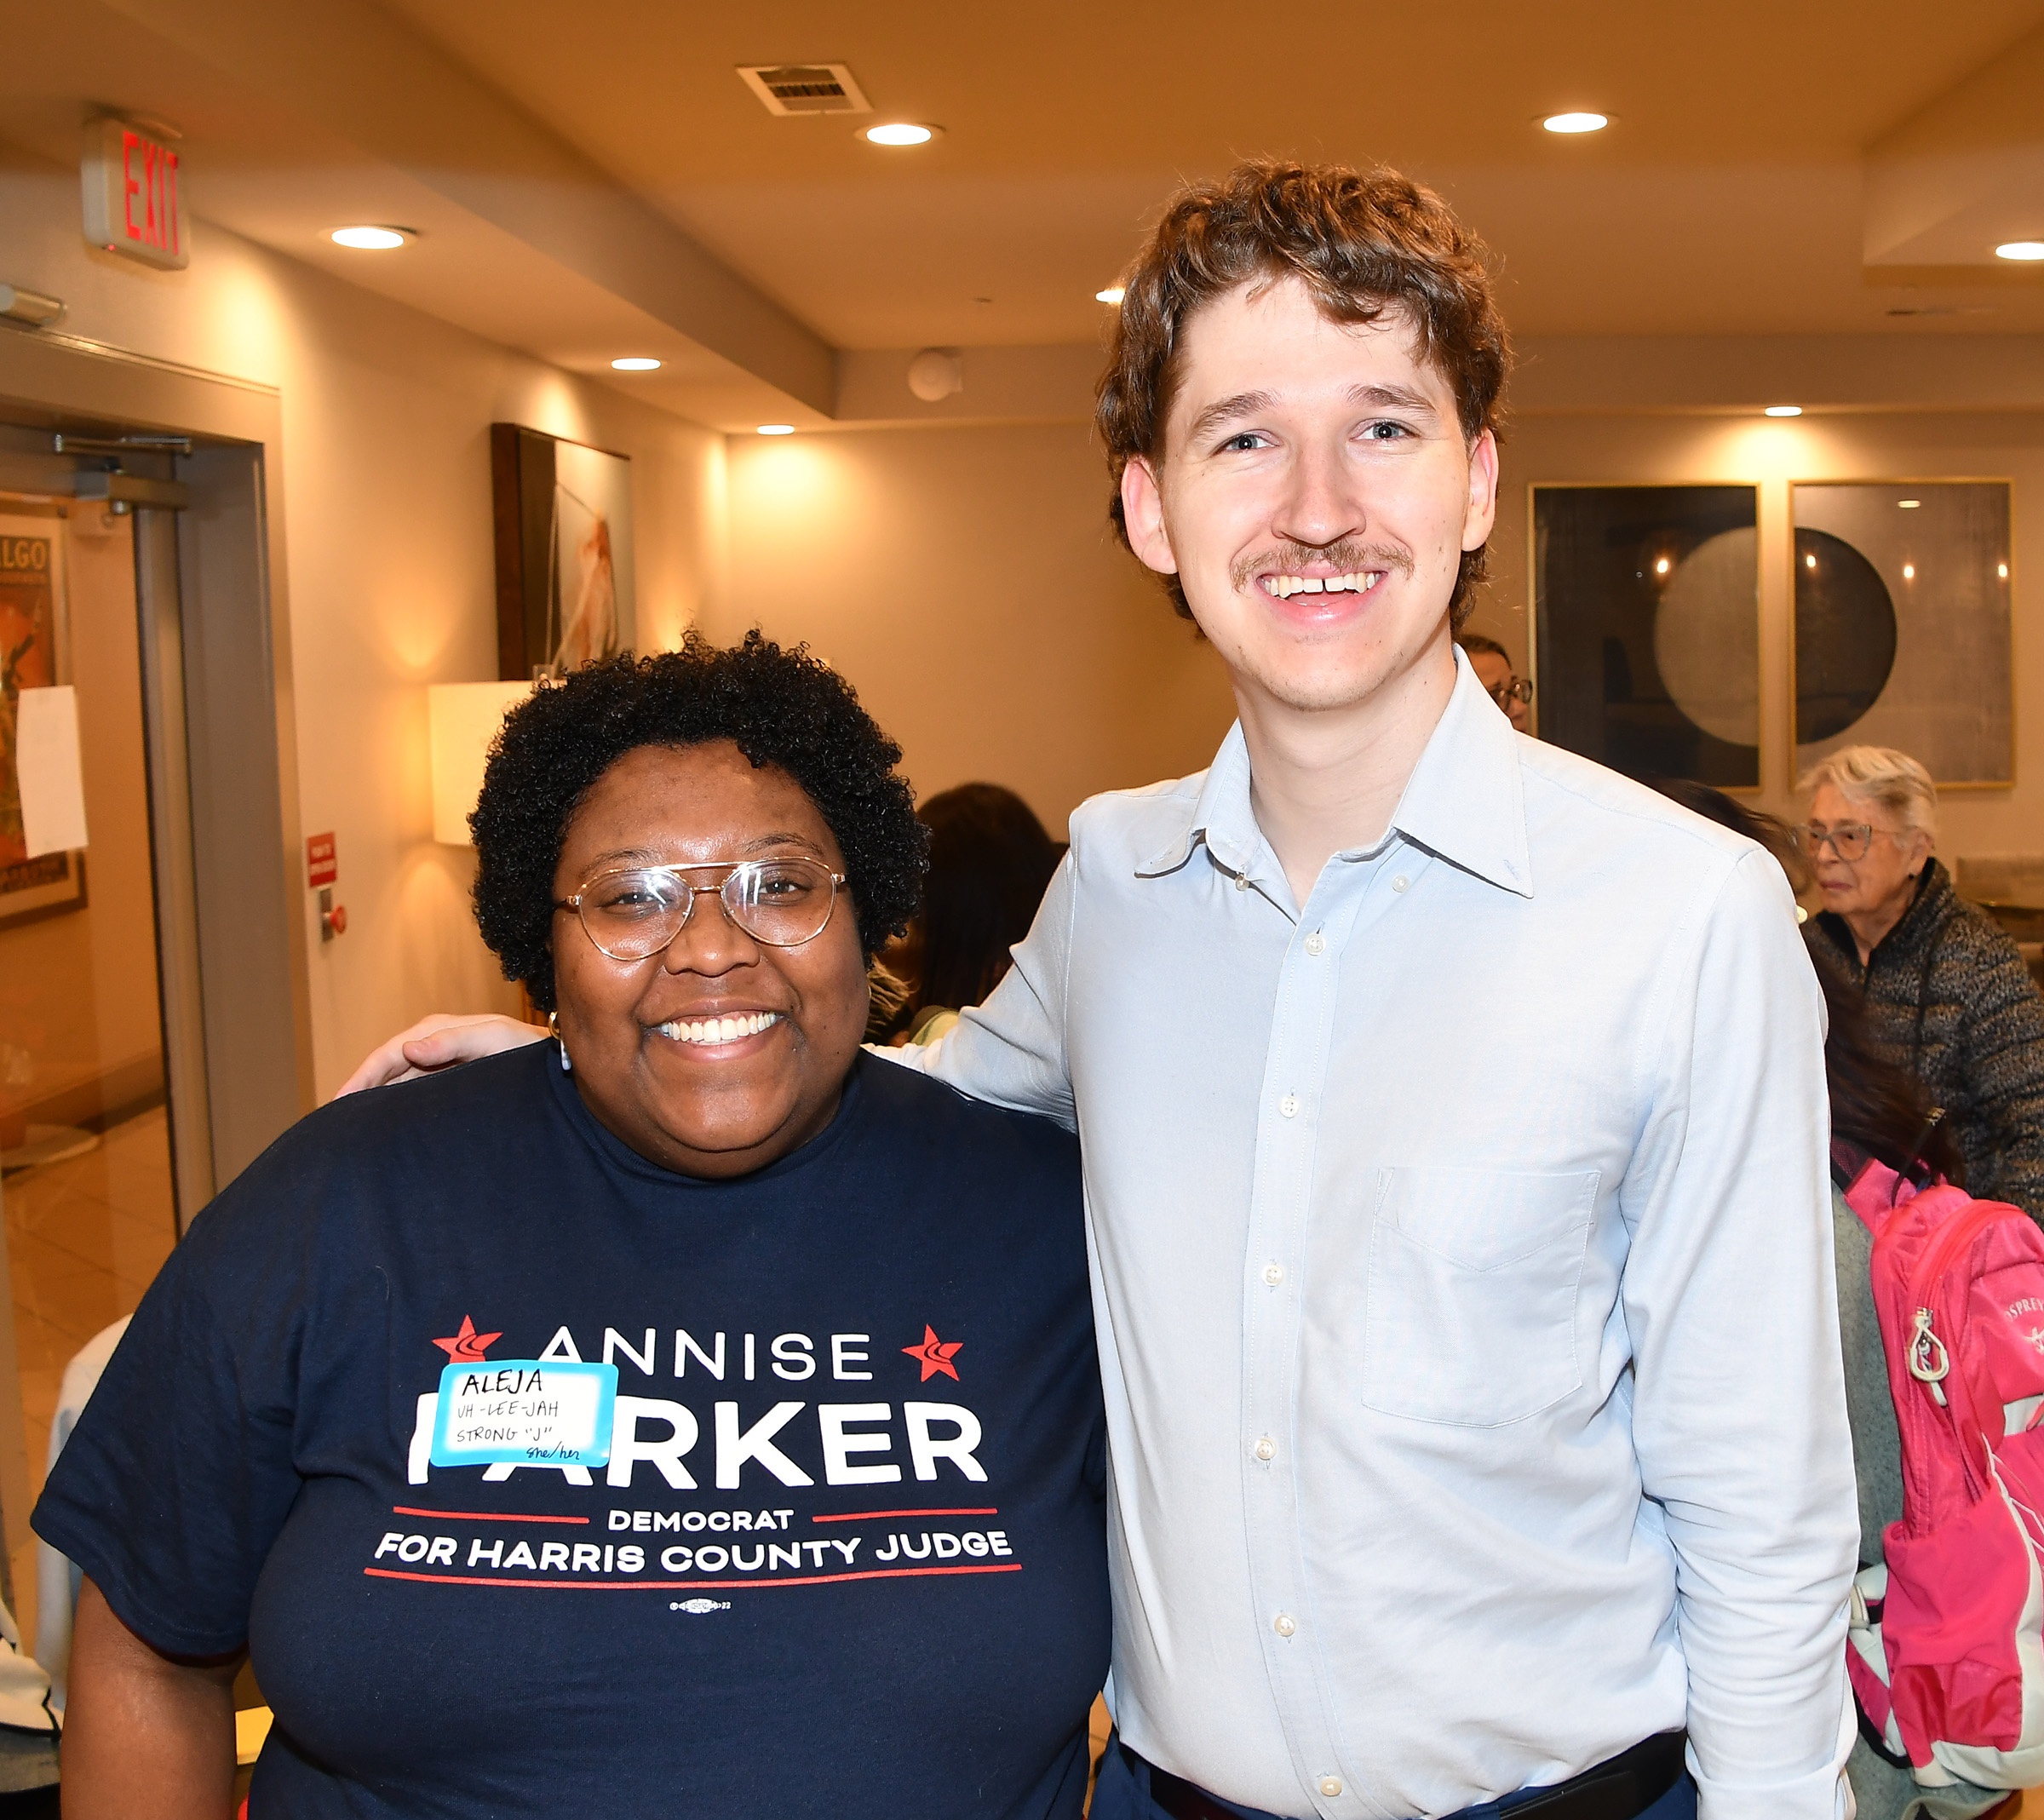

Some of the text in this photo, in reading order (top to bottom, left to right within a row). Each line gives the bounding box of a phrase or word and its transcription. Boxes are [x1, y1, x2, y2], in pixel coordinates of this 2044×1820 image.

[123, 130, 179, 255] EXIT
[0, 538, 47, 571] LGO
[537, 1325, 873, 1381] ANNISE
[462, 1368, 543, 1396] ALEJA
[407, 1392, 989, 1490] RKER
[456, 1426, 519, 1443] STRONG
[525, 1440, 581, 1461] she/her
[608, 1509, 795, 1532] DEMOCRAT
[374, 1530, 1013, 1573] FOR HARRIS COUNTY JUDGE
